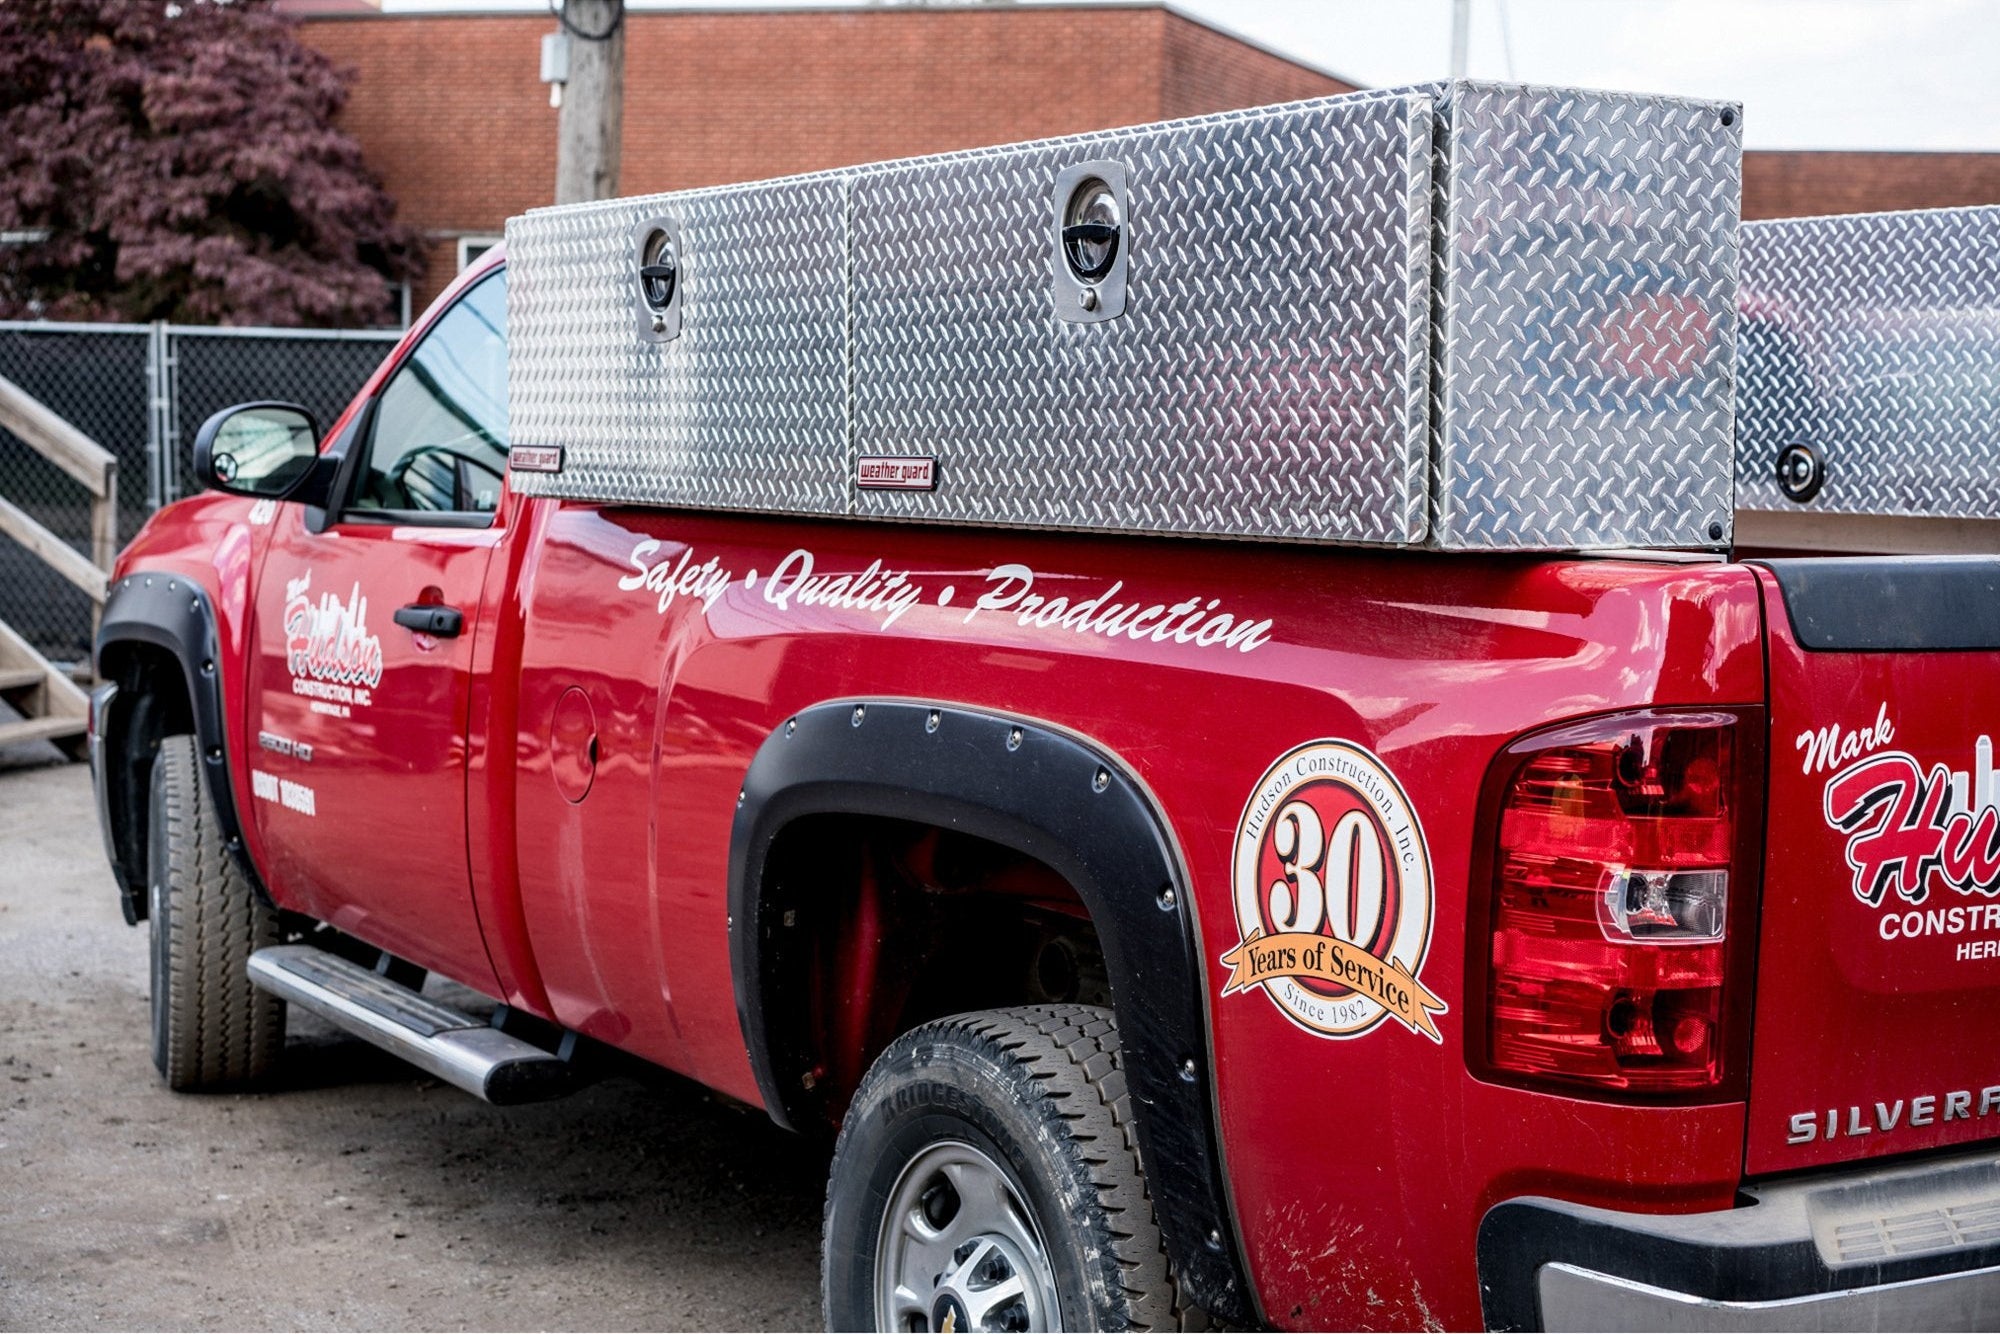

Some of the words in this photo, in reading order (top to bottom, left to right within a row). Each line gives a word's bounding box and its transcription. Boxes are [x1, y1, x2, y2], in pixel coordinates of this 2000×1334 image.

[513, 450, 538, 463] weather
[539, 451, 558, 466] guard
[860, 462, 900, 478] weather
[901, 463, 929, 482] guard
[617, 538, 732, 614] Safety
[762, 548, 920, 632] Quality
[962, 563, 1274, 654] Production
[1795, 700, 1896, 776] Mark
[1245, 771, 1292, 842] Hudson
[1295, 756, 1395, 824] Construction,
[1395, 824, 1417, 873] Inc.
[1268, 799, 1388, 951] 30
[1247, 946, 1297, 977] Years
[1303, 941, 1326, 971] of
[1330, 945, 1410, 1015] Service
[1956, 940, 2000, 961] HER
[1284, 983, 1325, 1021] Since
[1332, 999, 1368, 1024] 1982
